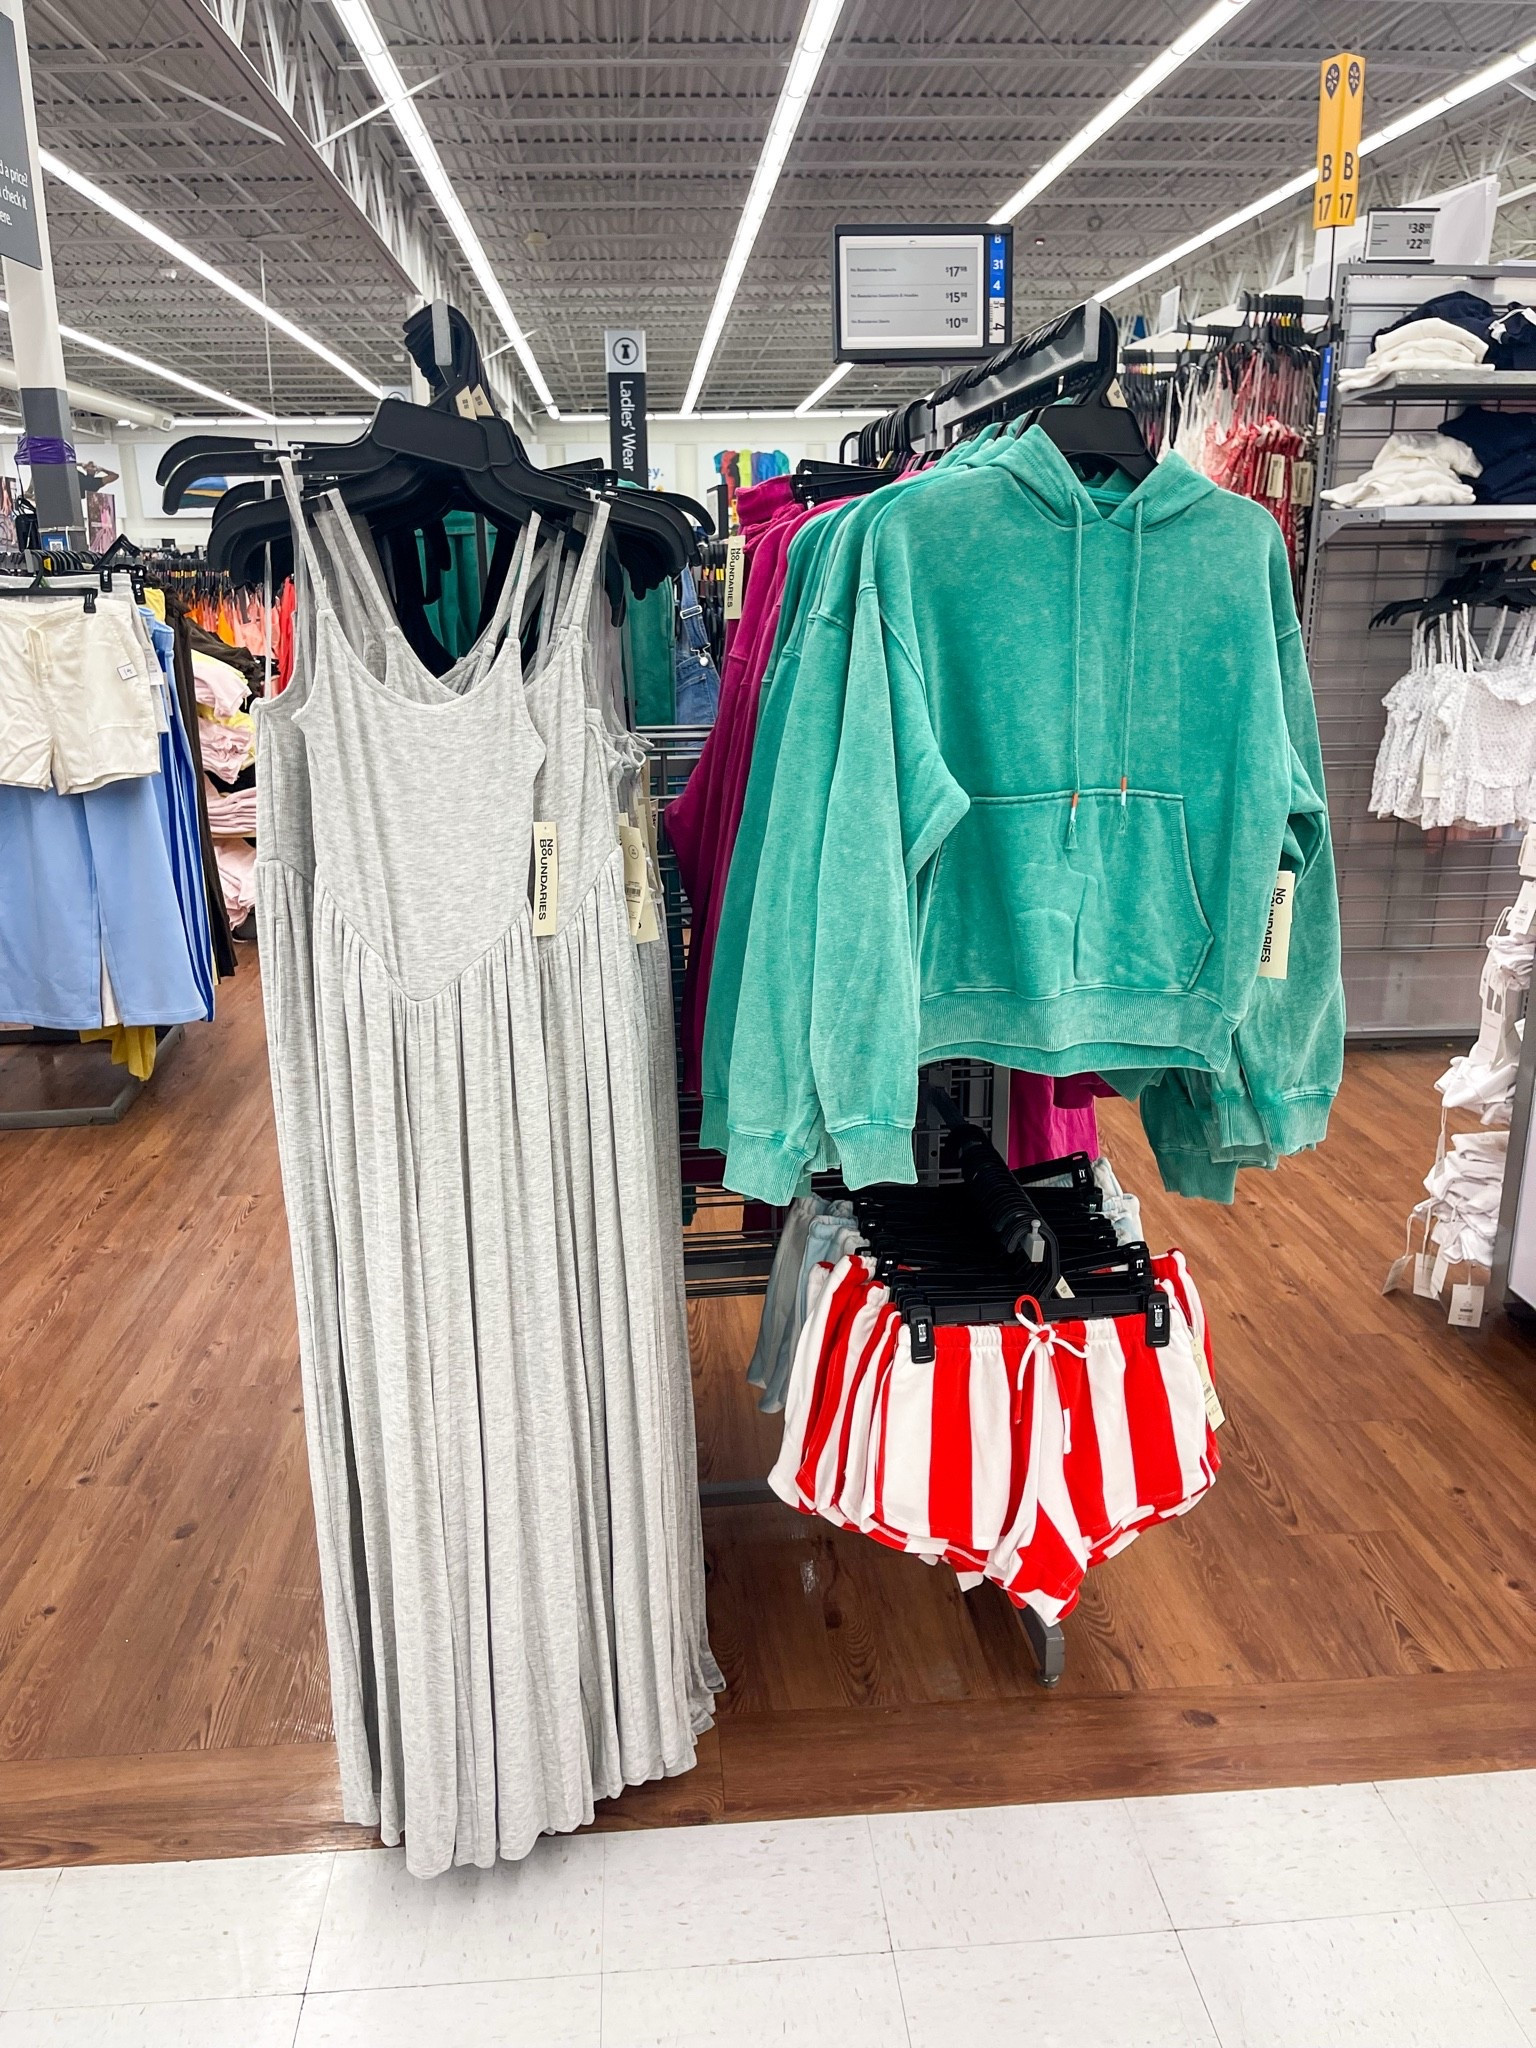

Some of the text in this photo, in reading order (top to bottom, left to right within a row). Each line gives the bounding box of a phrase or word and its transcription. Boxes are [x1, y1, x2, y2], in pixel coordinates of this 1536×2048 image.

[4, 165, 10, 178] a
[9, 168, 29, 188] price?
[1322, 154, 1332, 183] B
[1343, 151, 1354, 180] B
[2, 185, 22, 207] check
[1318, 193, 1332, 222] 17
[1339, 193, 1353, 219] 17
[0, 210, 13, 226] ere.
[992, 259, 1004, 270] 31
[992, 279, 1001, 291] 4
[621, 433, 637, 472] Wear
[735, 547, 741, 561] NO
[727, 548, 736, 608] BOUNDARIES
[546, 839, 554, 856] NO
[538, 839, 548, 921] BOUNDARIES
[1275, 887, 1287, 905] NO
[1260, 888, 1277, 963] DARIES
